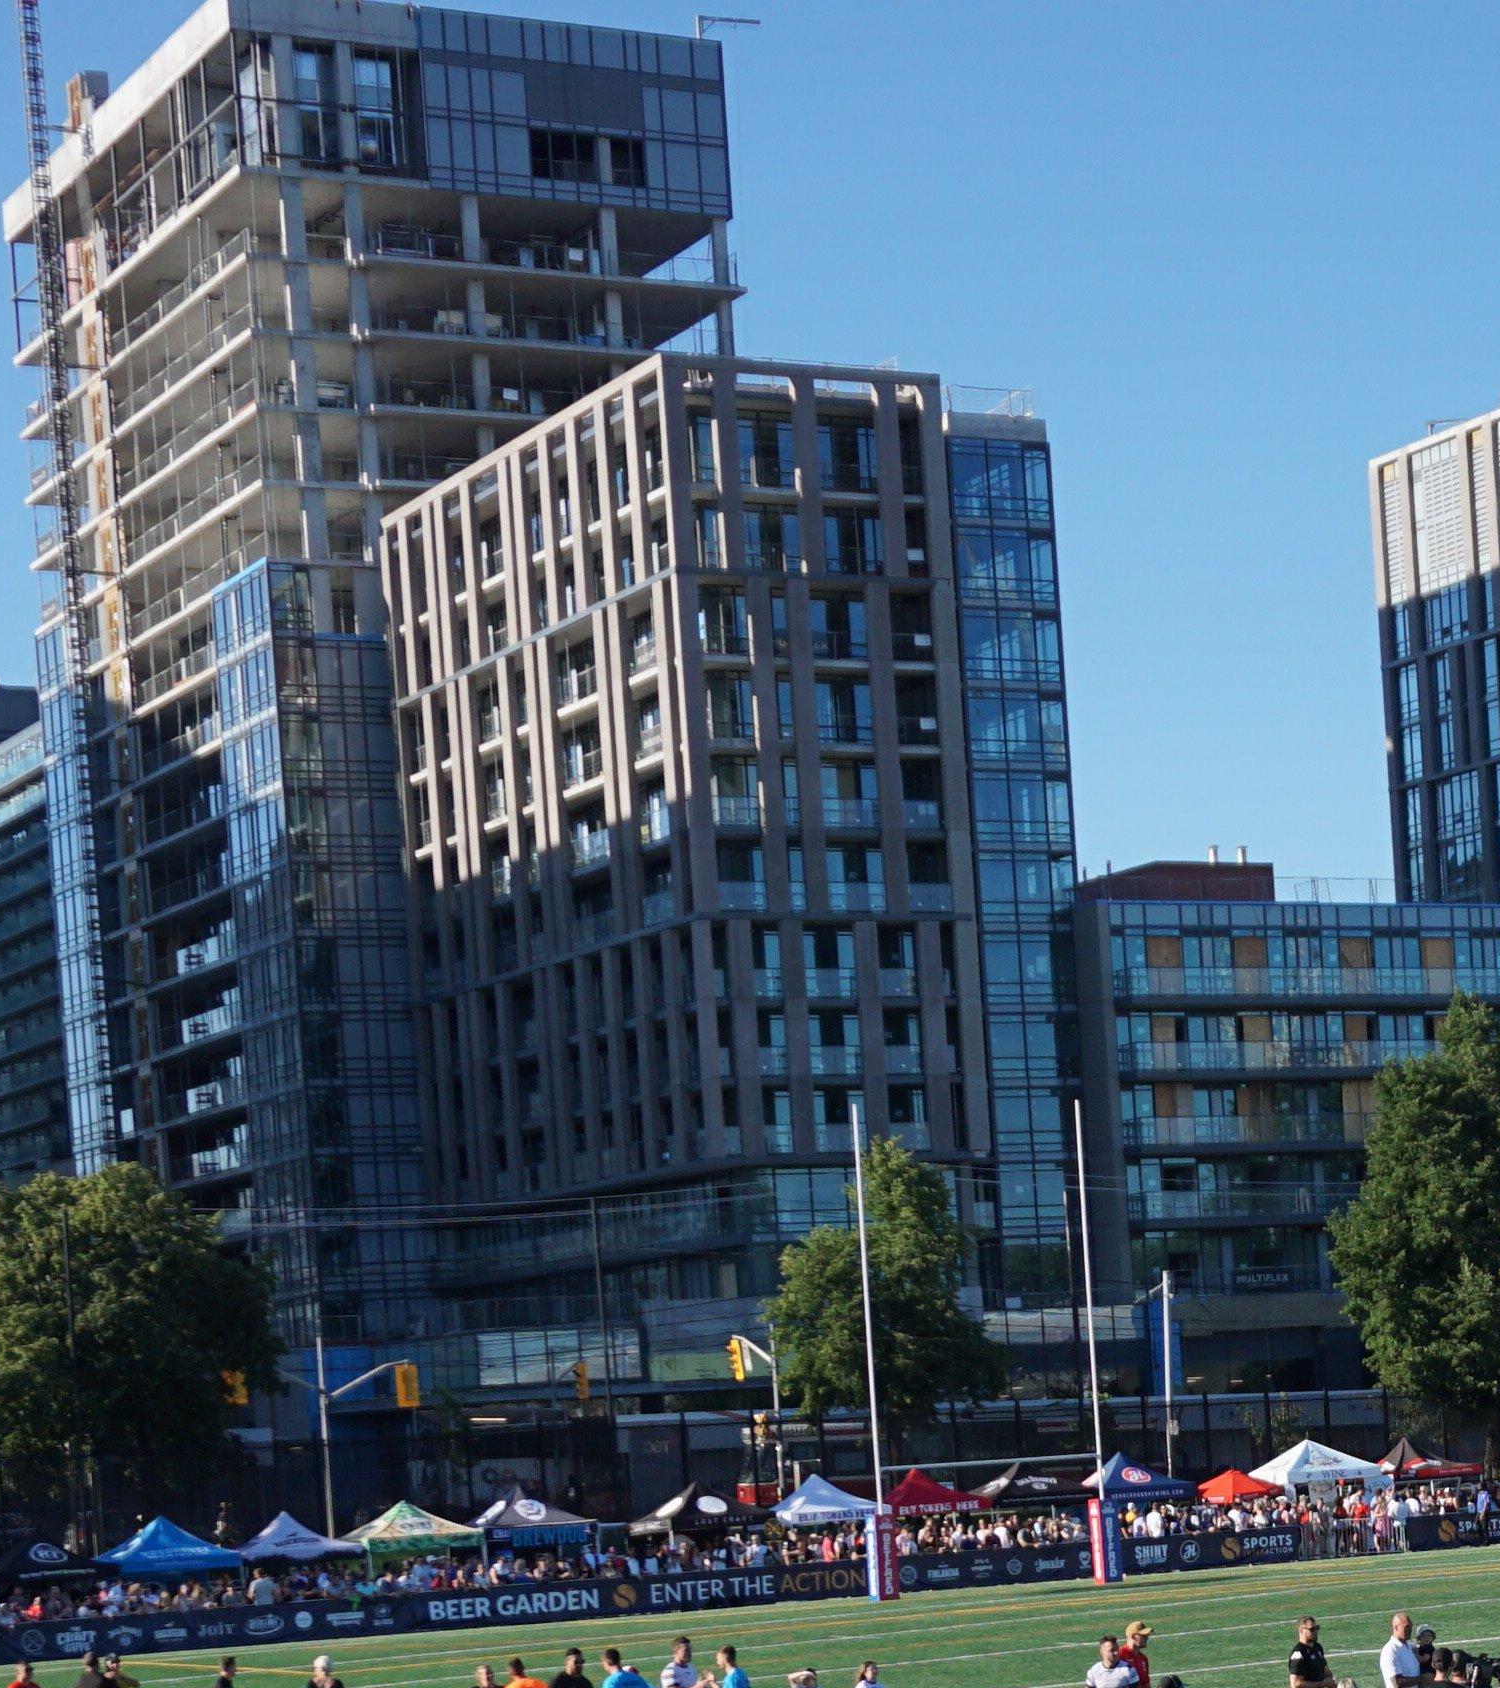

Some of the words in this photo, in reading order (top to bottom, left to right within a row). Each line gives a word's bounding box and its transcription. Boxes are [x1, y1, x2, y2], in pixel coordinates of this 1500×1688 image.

[1322, 1469, 1346, 1479] WINE
[899, 1504, 916, 1515] BUY
[956, 1499, 979, 1511] HERE
[1243, 1534, 1293, 1550] SPORTS
[1134, 1544, 1168, 1560] SHINY
[650, 1579, 725, 1605] ENTER
[728, 1574, 776, 1599] THE
[780, 1567, 867, 1594] ACTION
[428, 1597, 492, 1622] BEER
[496, 1588, 601, 1617] GARDEN
